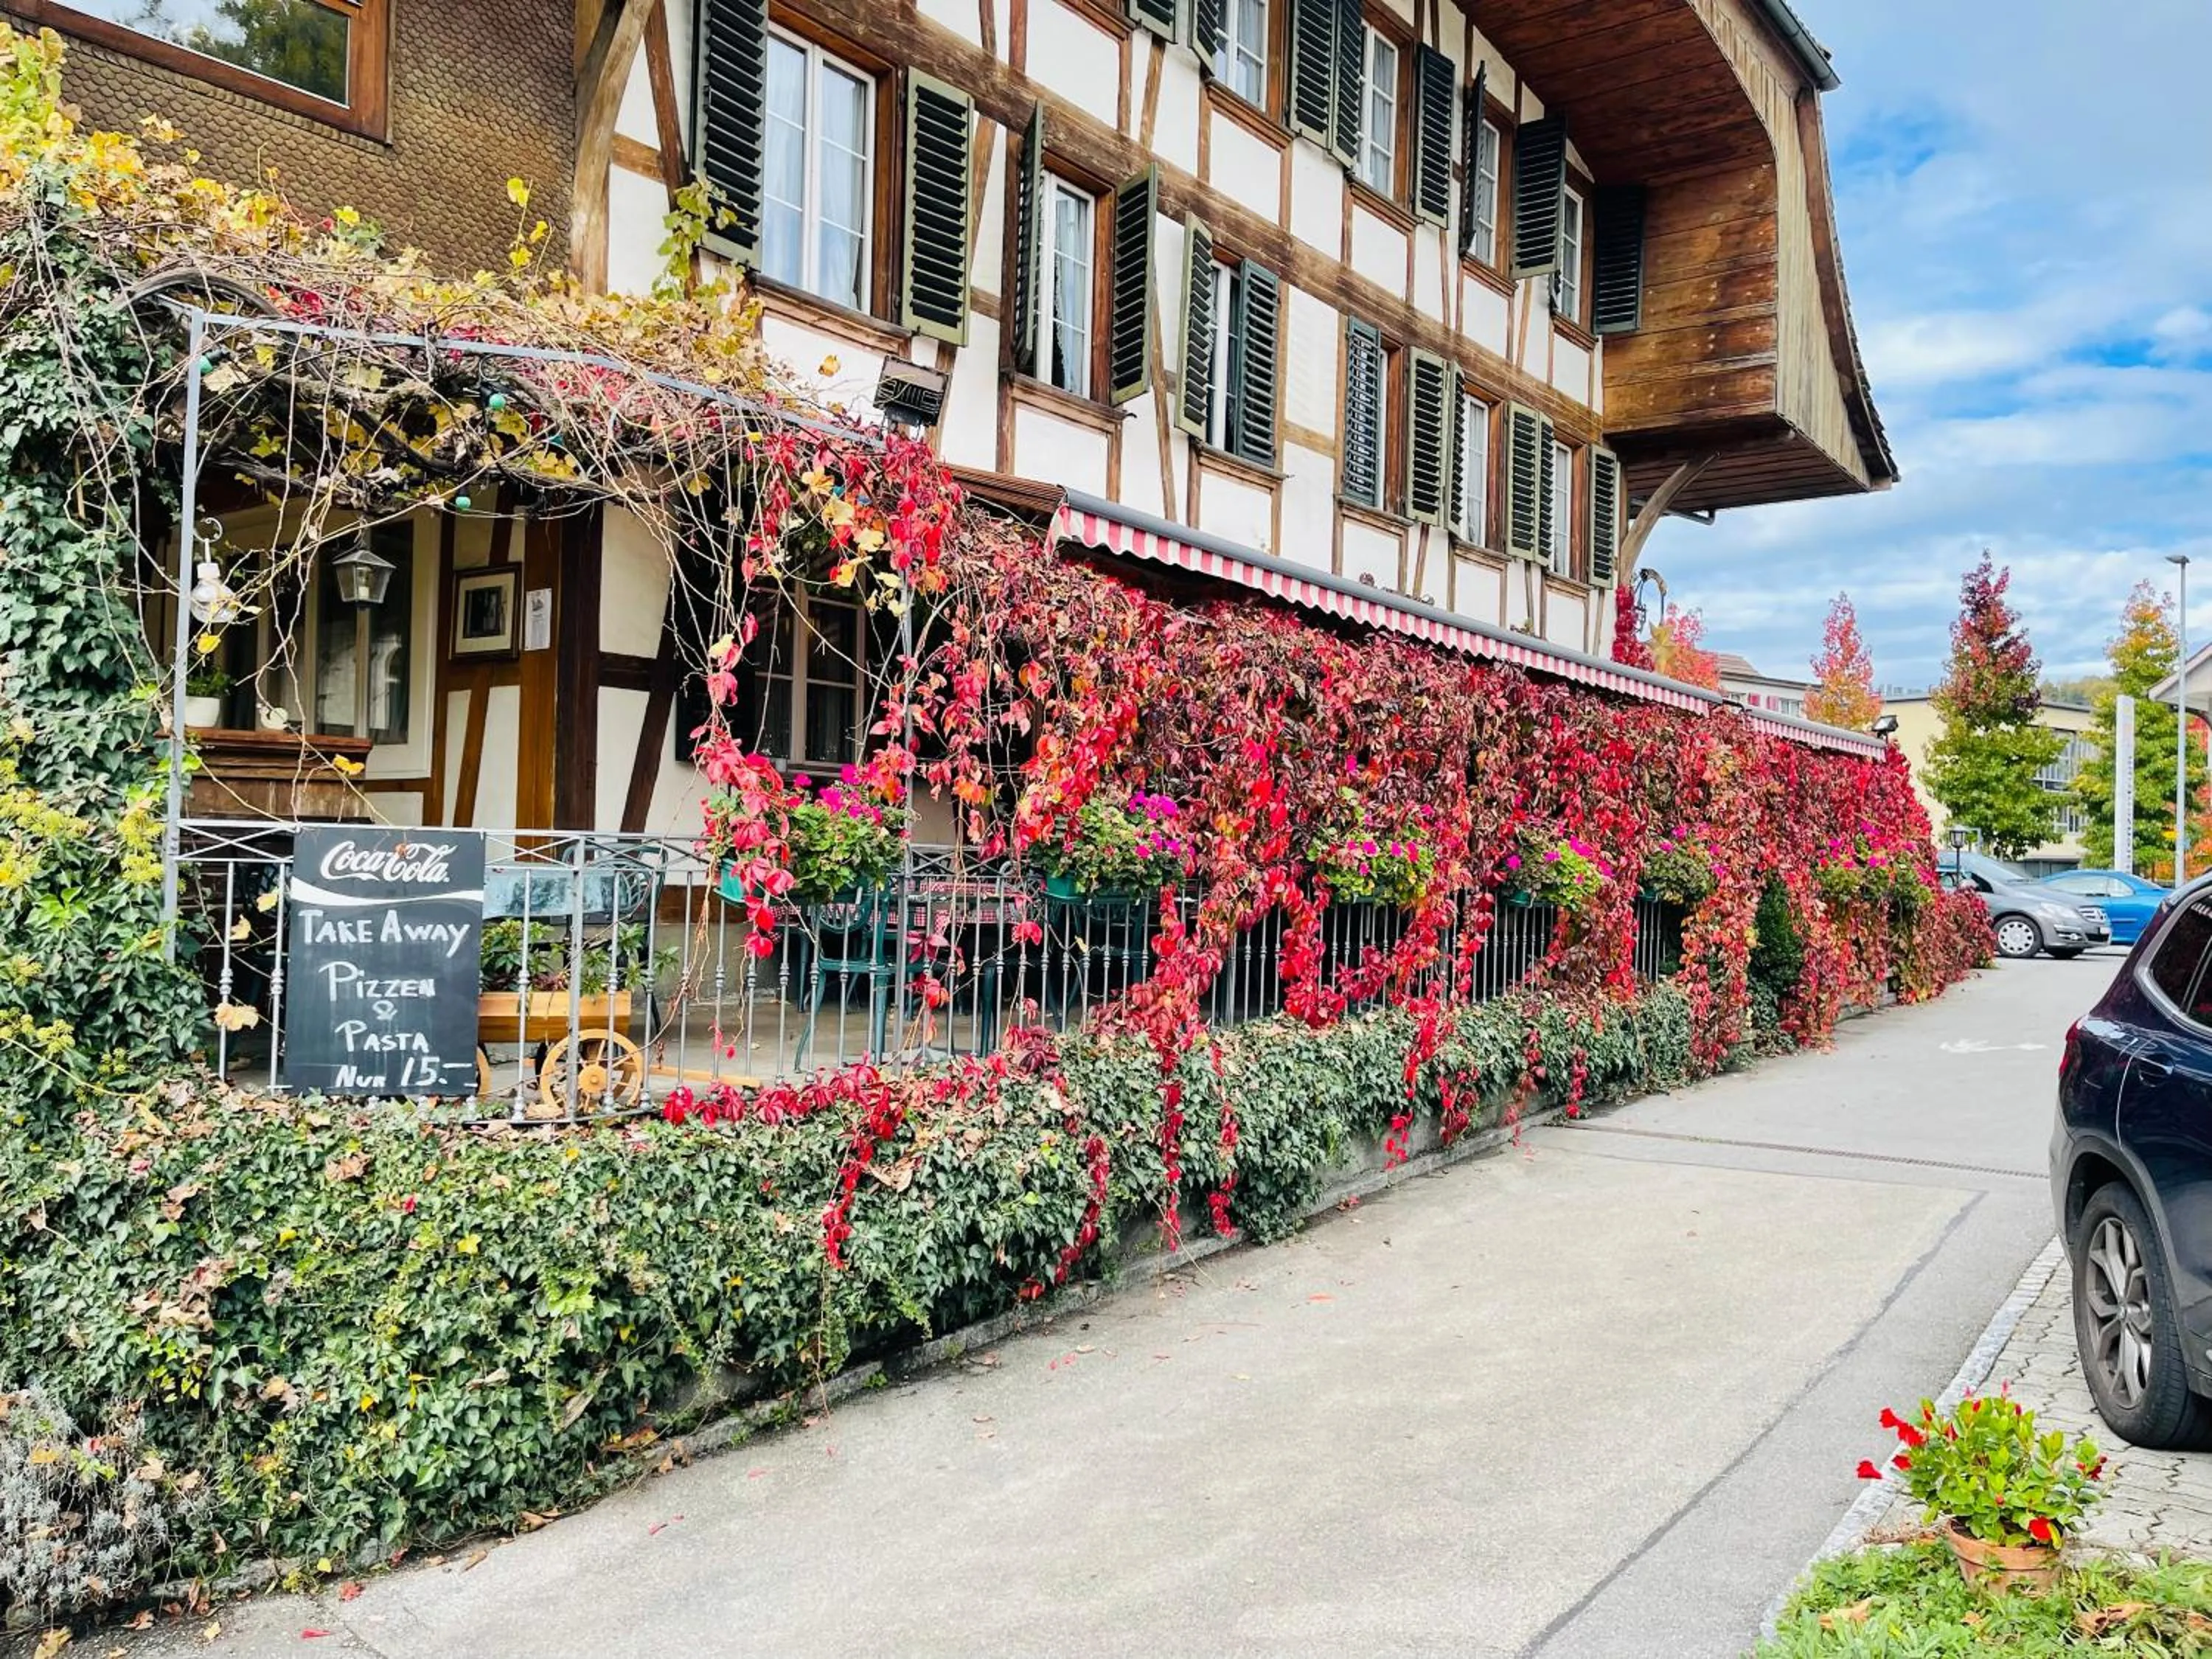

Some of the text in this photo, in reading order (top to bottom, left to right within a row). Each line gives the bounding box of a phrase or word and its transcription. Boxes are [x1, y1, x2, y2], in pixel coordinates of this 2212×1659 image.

[298, 909, 470, 958] TAKE AWAY
[372, 999, 398, 1020] &
[334, 1020, 429, 1053] PASTA
